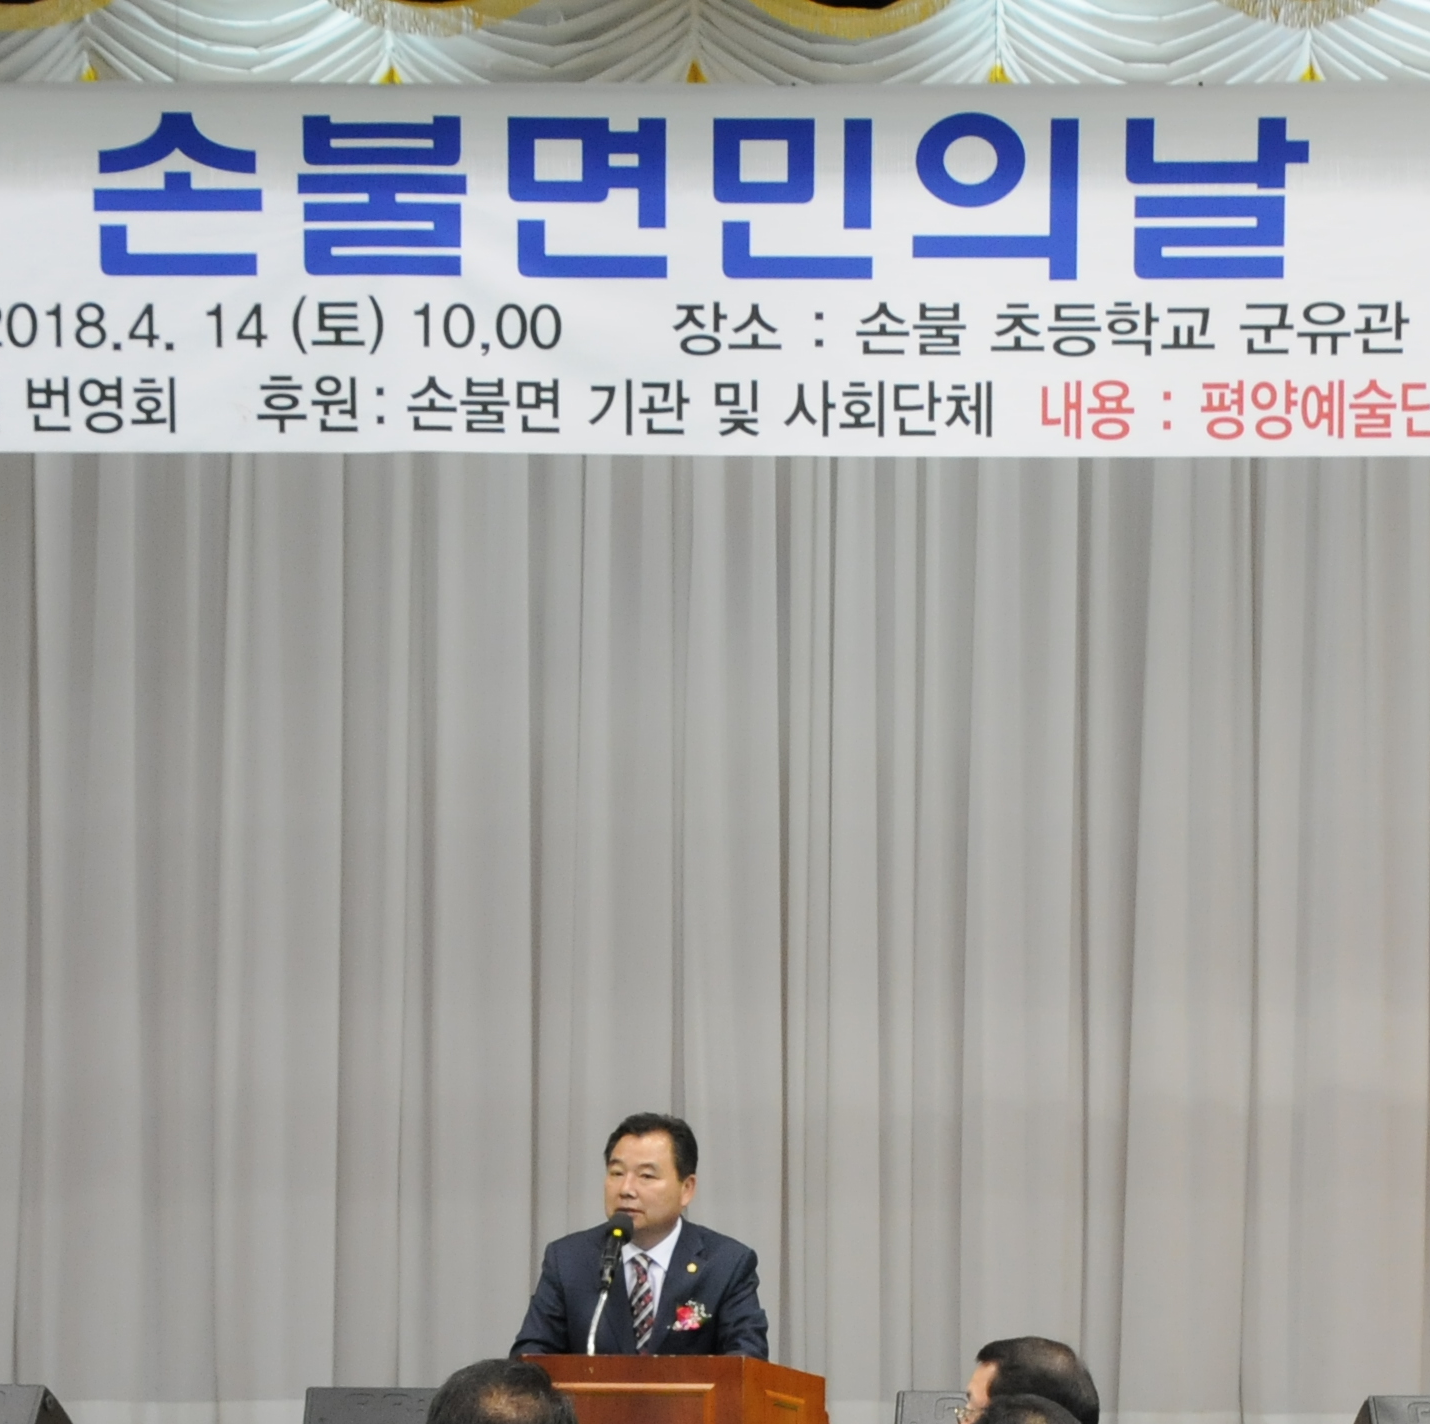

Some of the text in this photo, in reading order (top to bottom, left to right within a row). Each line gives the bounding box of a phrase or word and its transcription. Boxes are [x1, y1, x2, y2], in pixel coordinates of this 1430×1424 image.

[93, 112, 1310, 281] 손불면민의날
[207, 304, 267, 348] 14
[292, 296, 384, 354] (토)
[415, 303, 562, 352] 10,00
[674, 302, 781, 356] 장소
[856, 302, 966, 355] 손불
[991, 302, 1215, 357] 초등학교
[1240, 302, 1409, 355] 군유관
[27, 377, 176, 434] 번영회
[407, 376, 560, 433] 손불면
[589, 379, 690, 436] 기관
[715, 380, 759, 436] 및
[784, 380, 993, 437] 사회단체
[1041, 379, 1135, 441] 내용
